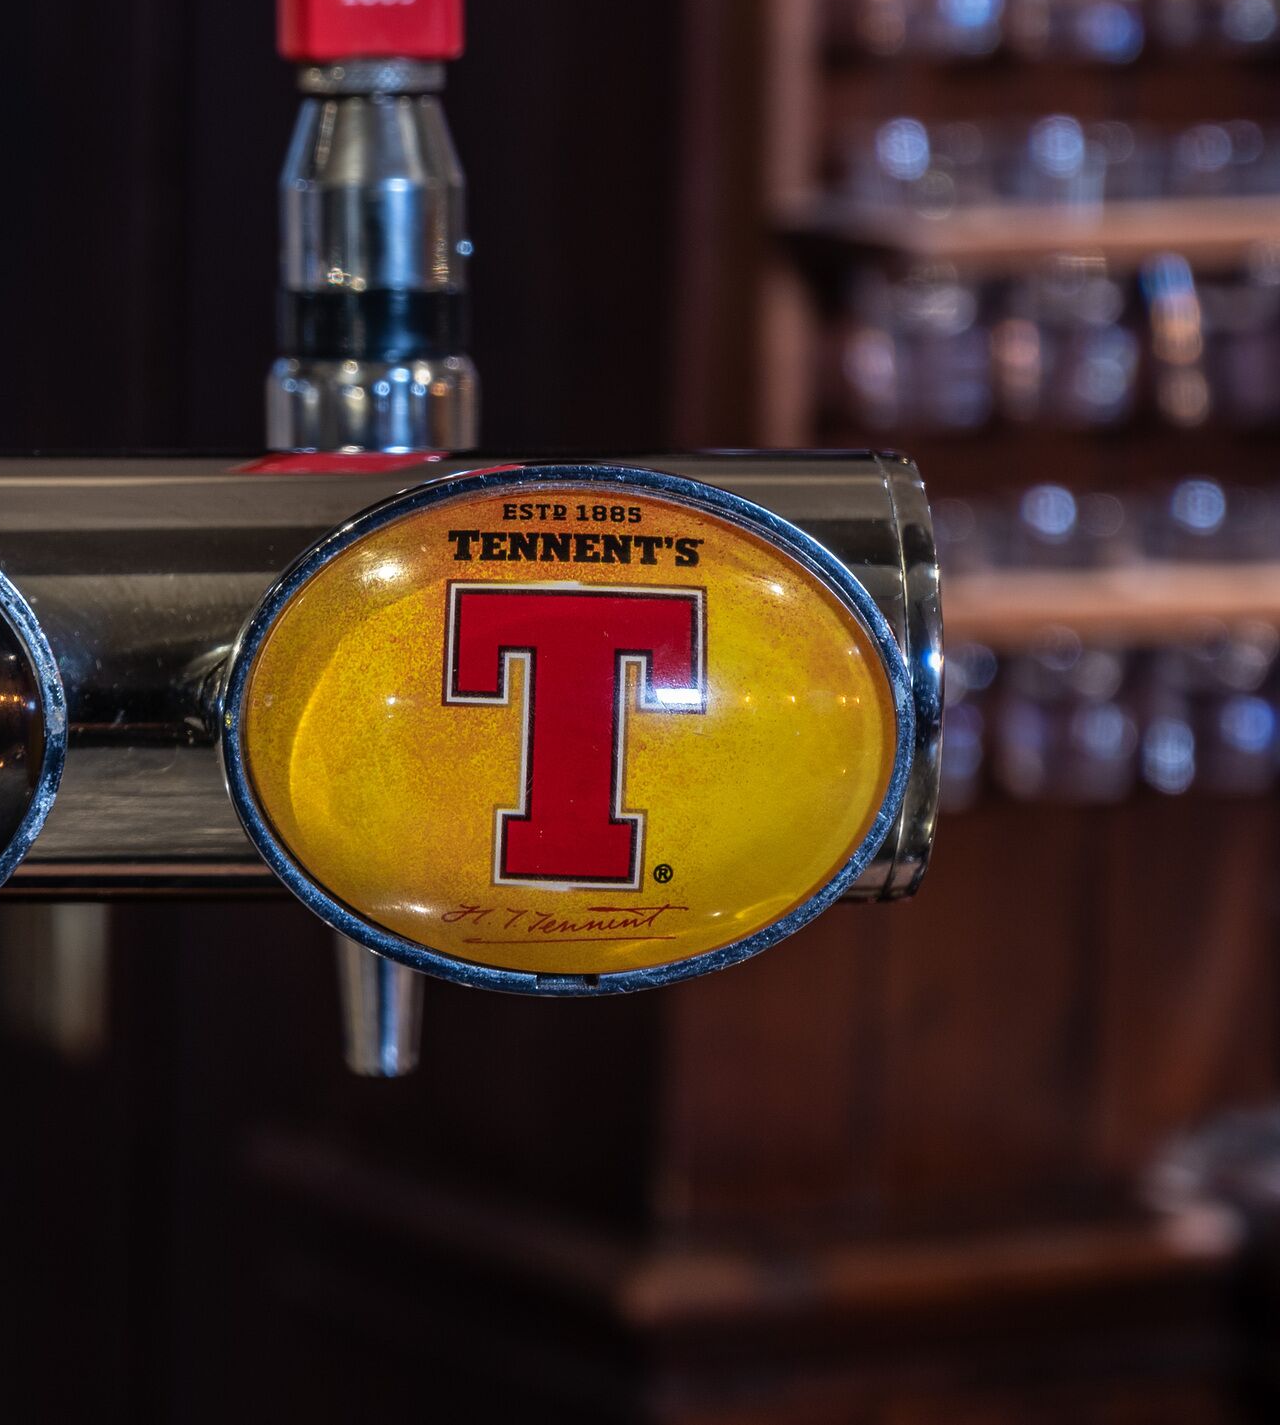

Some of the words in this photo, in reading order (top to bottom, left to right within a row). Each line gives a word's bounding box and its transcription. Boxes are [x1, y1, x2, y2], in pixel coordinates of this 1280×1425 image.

[503, 503, 568, 521] ESTD
[576, 505, 643, 524] 1885
[448, 529, 705, 567] TENNENT'S
[442, 579, 708, 892] T
